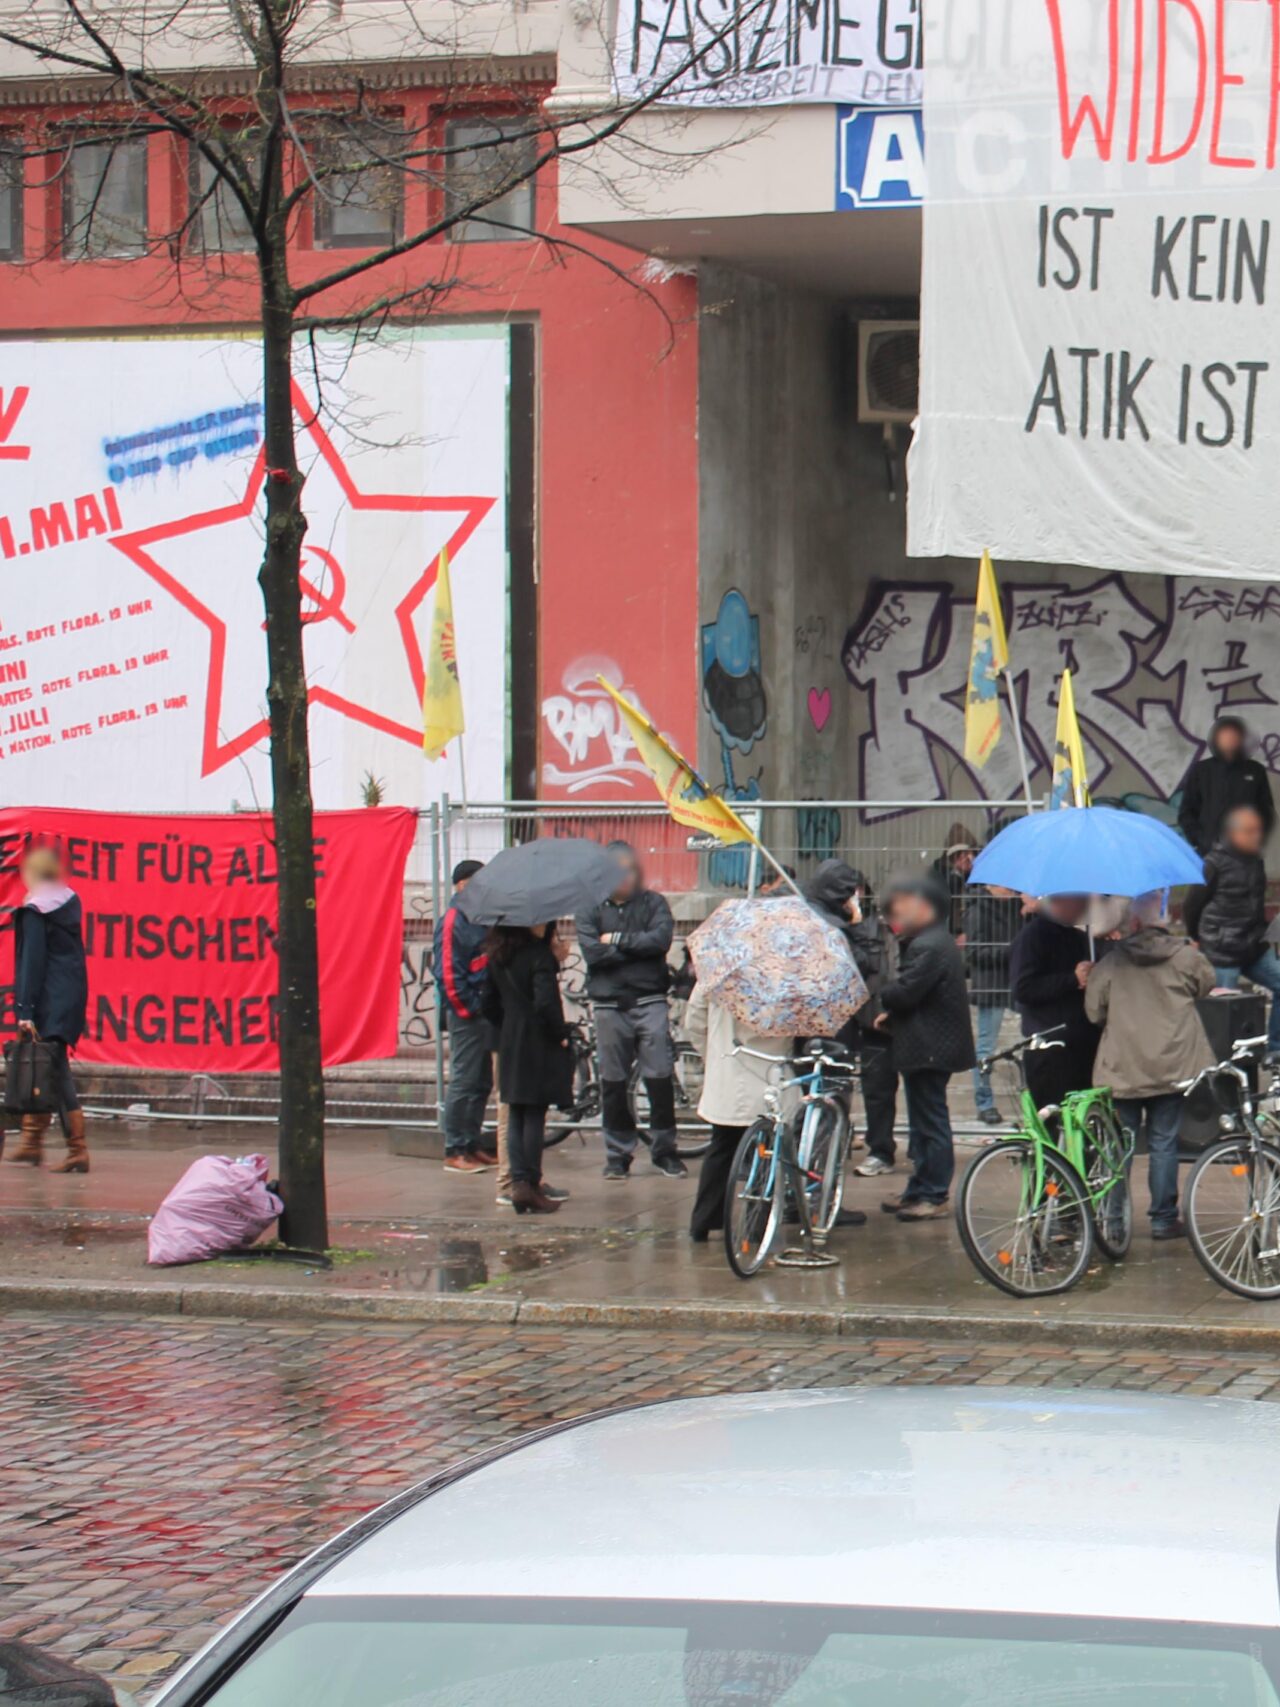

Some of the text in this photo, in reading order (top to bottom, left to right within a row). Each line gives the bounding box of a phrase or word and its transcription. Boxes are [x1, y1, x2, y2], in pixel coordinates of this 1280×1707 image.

[1036, 204, 1113, 291] IST
[1151, 214, 1270, 305] KEIN
[1024, 346, 1154, 442] ATIK
[1177, 361, 1269, 448] IST
[26, 624, 57, 643] ROTE
[127, 599, 153, 616] UHR
[41, 677, 72, 695] ROTE
[142, 649, 169, 665] UHR
[61, 722, 93, 741] ROTE
[136, 833, 212, 887] FÜR
[226, 837, 328, 887] ALE
